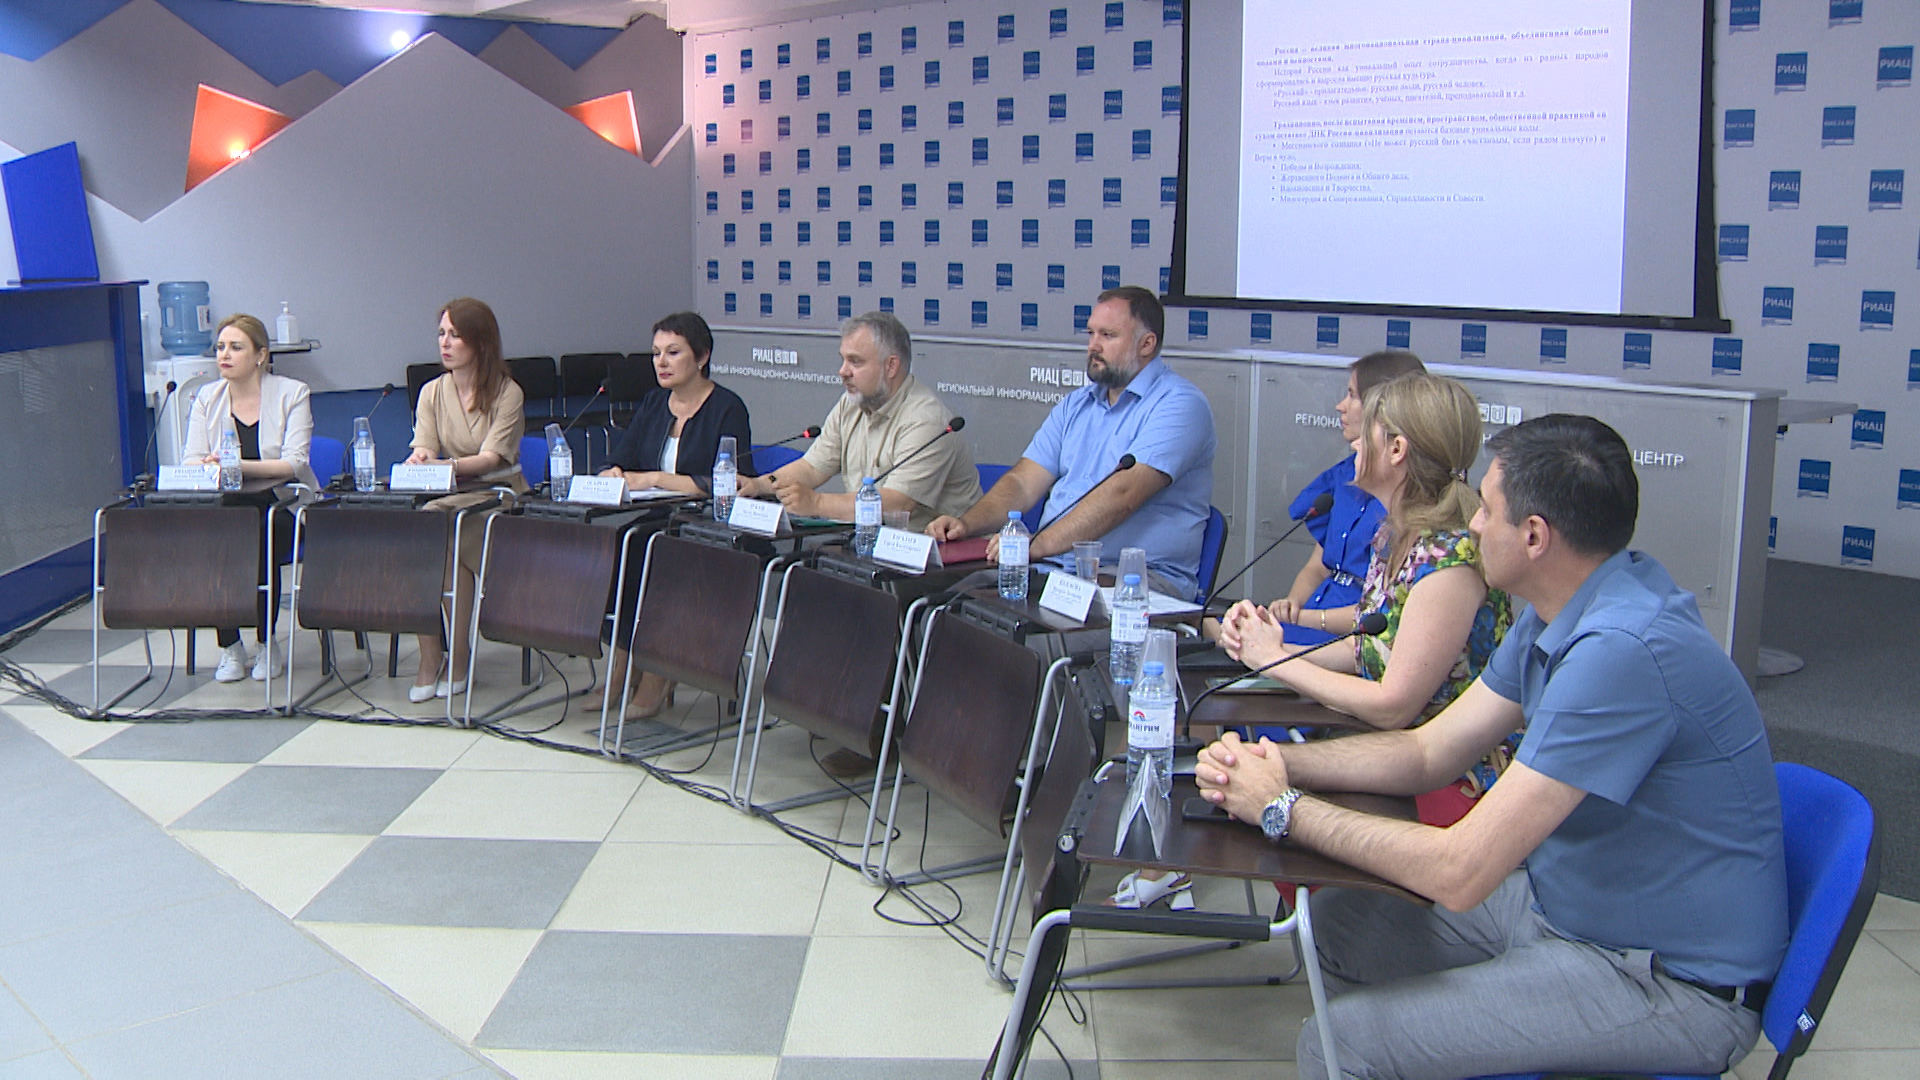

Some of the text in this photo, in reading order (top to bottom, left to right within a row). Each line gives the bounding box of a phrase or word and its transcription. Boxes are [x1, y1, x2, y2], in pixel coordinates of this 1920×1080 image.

[1777, 64, 1806, 74] РИАЦ
[1880, 58, 1911, 69] РИАЦ
[1771, 181, 1799, 192] РИАЦ
[1871, 181, 1902, 192] РИАЦ
[1764, 297, 1792, 309] РИАЦ
[1863, 301, 1893, 313] РИАЦ
[752, 347, 774, 365] РИАЦ
[1030, 366, 1060, 388] РИАЦ
[937, 381, 995, 397] РЕГИОНАЛЬНЫЙ
[1854, 421, 1883, 432] РИАЦ
[1633, 449, 1684, 467] ЦЕНТР
[1844, 537, 1873, 549] РИАЦ
